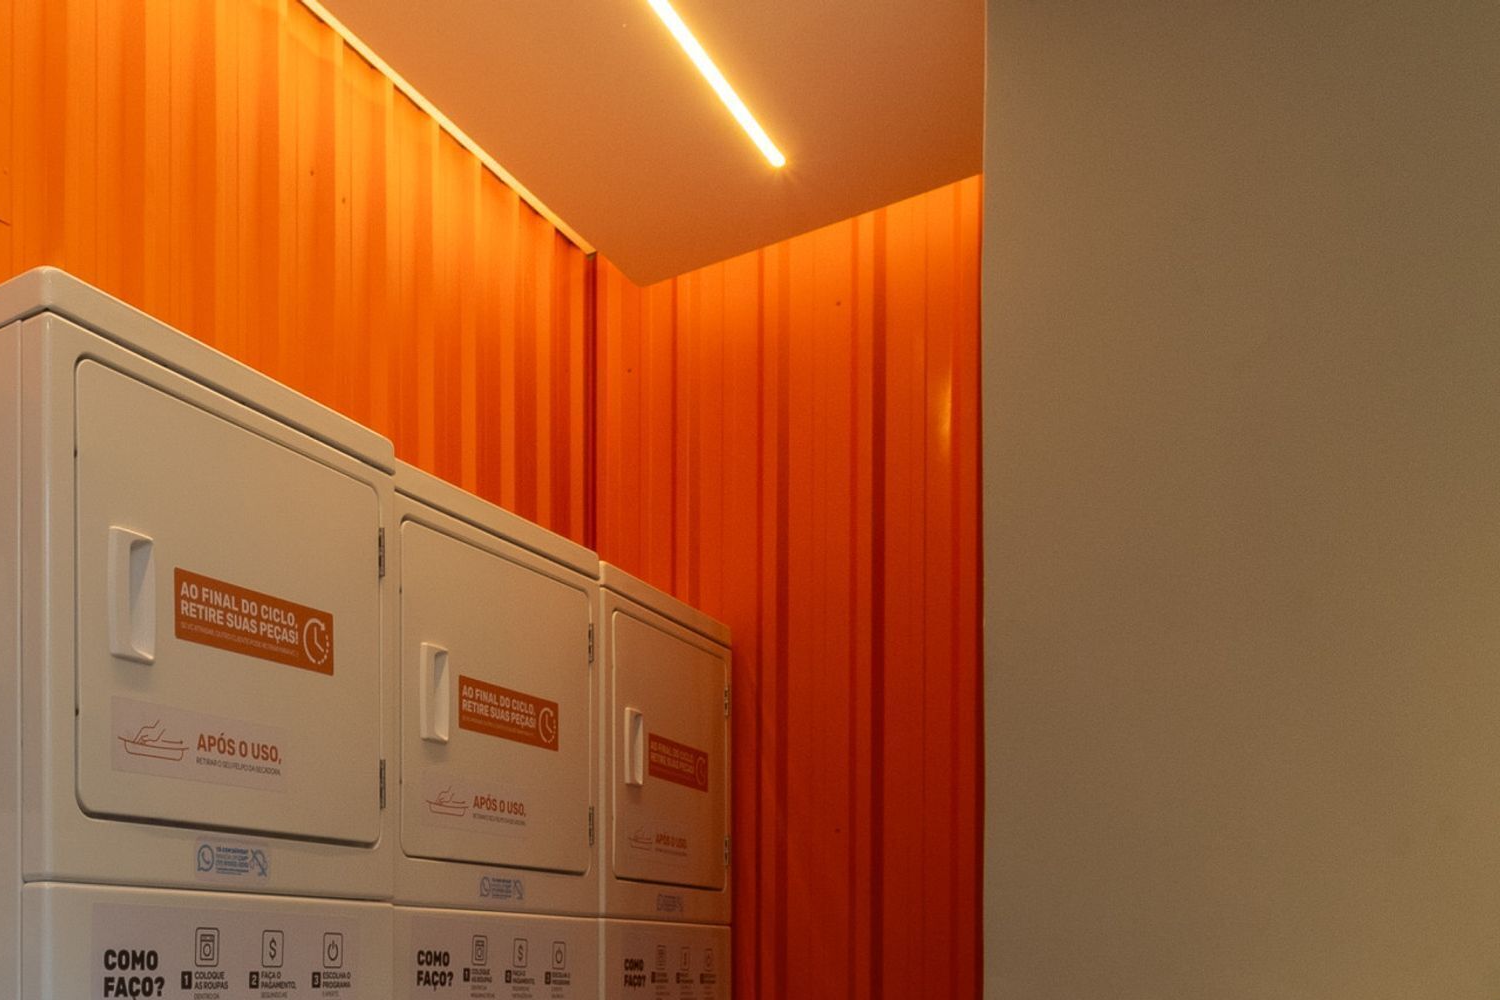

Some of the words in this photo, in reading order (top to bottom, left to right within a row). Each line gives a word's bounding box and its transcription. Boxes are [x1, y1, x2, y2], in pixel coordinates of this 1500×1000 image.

[180, 582, 198, 600] AO
[201, 586, 239, 612] FINAL
[241, 598, 258, 617] DO
[260, 604, 299, 630] CICLO,
[180, 599, 225, 626] RETIRE
[225, 612, 258, 635] SUAS
[259, 621, 299, 646] PEÇAS!
[462, 684, 474, 699] AO
[474, 688, 499, 706] FINAL
[499, 695, 511, 709] DO
[462, 699, 490, 718] RETIRE
[490, 706, 510, 723] SUAS
[197, 732, 236, 756] APÓS
[239, 740, 248, 758] O
[251, 742, 282, 765] USO,
[473, 794, 498, 812] APÓS
[499, 799, 506, 813] O
[103, 949, 159, 971] COMO
[417, 950, 450, 967] COMO
[194, 971, 225, 980] COLOQUE
[194, 981, 203, 990] AS
[203, 981, 229, 990] ROUPAS
[416, 970, 454, 992] FAÇO?
